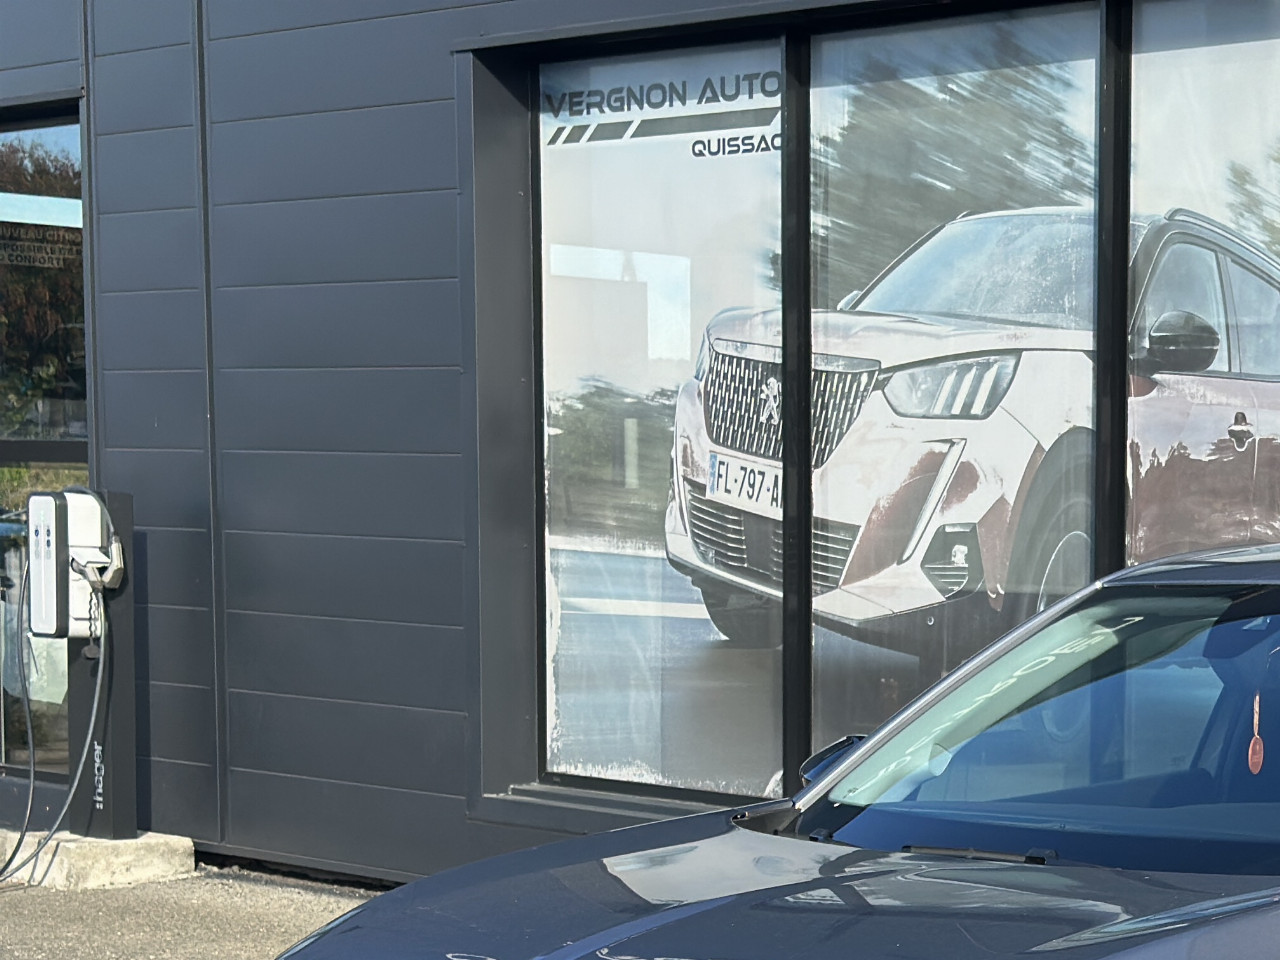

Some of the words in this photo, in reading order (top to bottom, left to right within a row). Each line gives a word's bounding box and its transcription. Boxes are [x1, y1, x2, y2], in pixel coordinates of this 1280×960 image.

[545, 80, 687, 119] VERGNON
[697, 71, 781, 105] AUTO
[692, 134, 781, 157] QUISSAC
